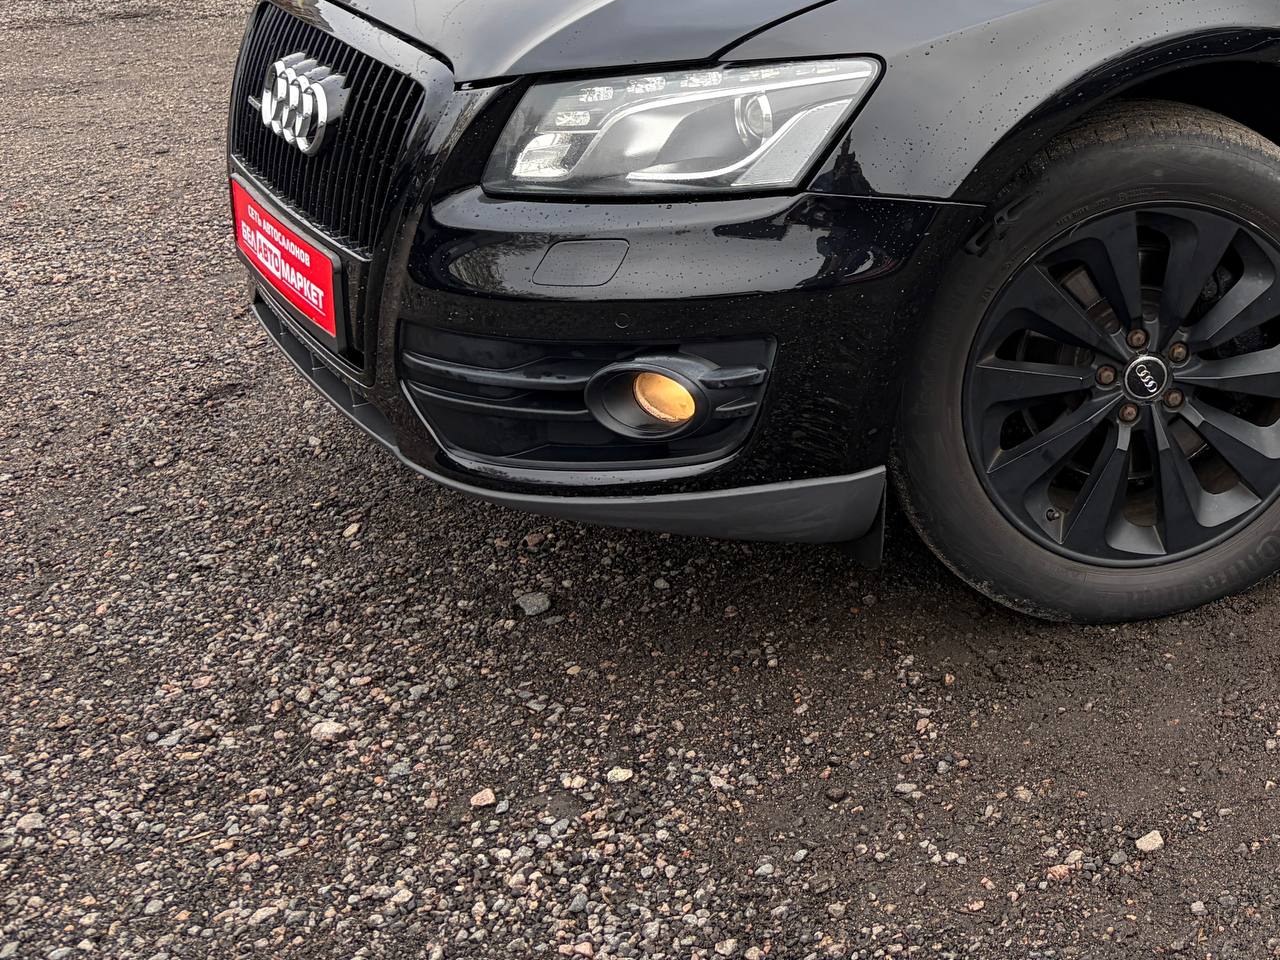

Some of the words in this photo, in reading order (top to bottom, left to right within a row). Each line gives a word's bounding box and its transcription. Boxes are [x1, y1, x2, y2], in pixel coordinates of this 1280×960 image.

[241, 220, 257, 253] БЕЛ
[258, 237, 281, 278] АВТО
[280, 259, 325, 309] МАРКЕТ
[248, 205, 262, 227] СЕТЬ
[262, 219, 311, 267] АВТОСАЛОНОВ
